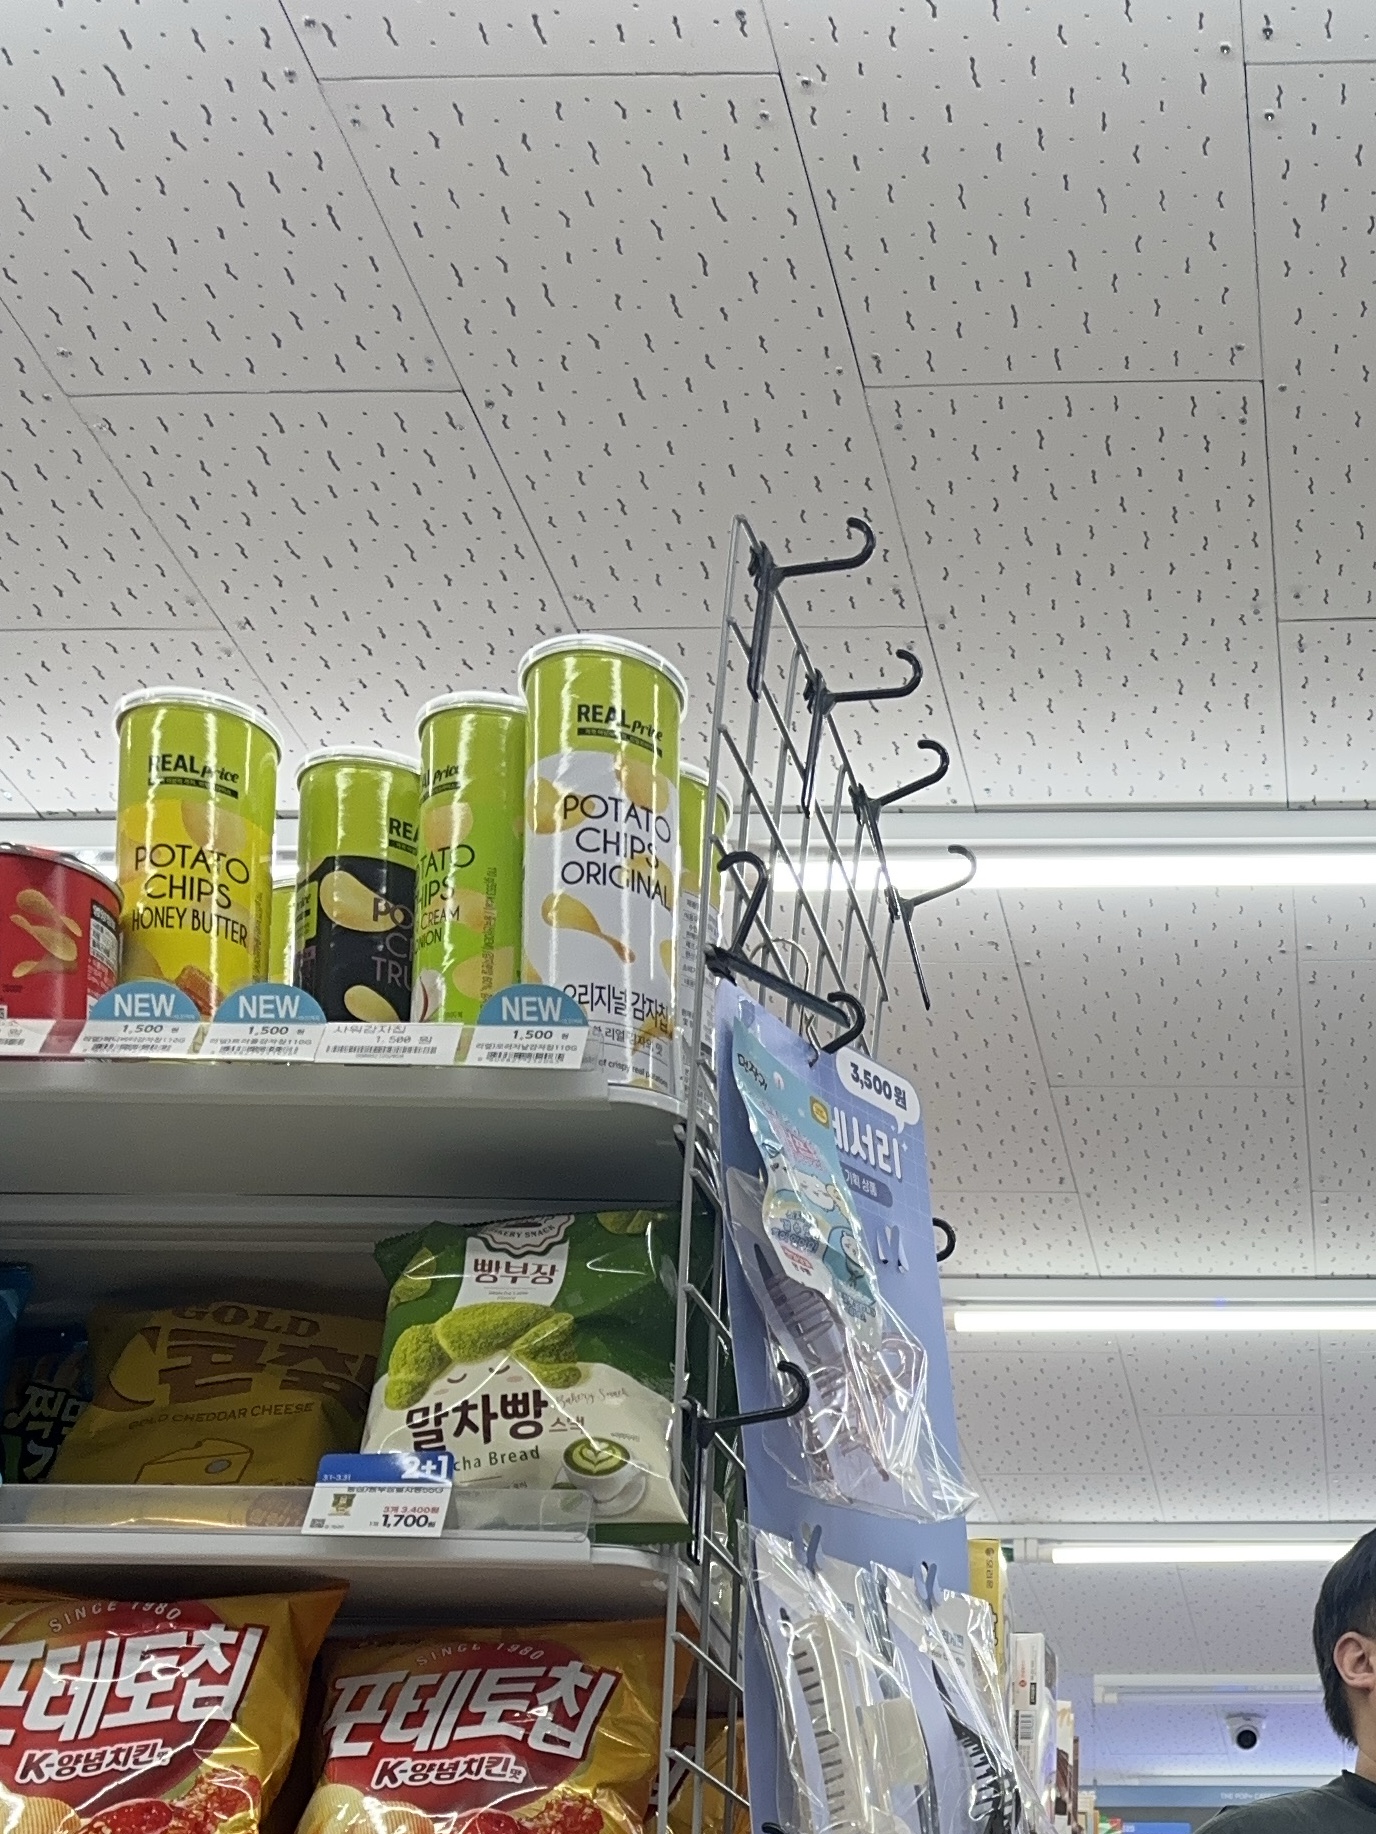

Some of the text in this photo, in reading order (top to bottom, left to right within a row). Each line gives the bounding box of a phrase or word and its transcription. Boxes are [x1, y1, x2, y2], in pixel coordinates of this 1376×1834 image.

[577, 704, 630, 729] REAL
[563, 794, 671, 843] POTATO
[576, 827, 660, 870] CHIPS
[135, 843, 250, 885] POTATO
[144, 874, 232, 910] CHIPS
[562, 861, 671, 911] ORIGINAL
[132, 906, 247, 947] HONEY BUTTER
[421, 906, 460, 931] CREAM
[114, 994, 176, 1018] NEW
[239, 995, 300, 1019] NEW
[502, 996, 563, 1022] NEW
[122, 1024, 164, 1036] 1,500
[248, 1026, 289, 1037] 1,500
[513, 1030, 553, 1041] 1,500
[473, 1258, 559, 1285] 빵부장
[172, 1304, 321, 1338] GOLD
[173, 1407, 247, 1424] CHEDDAR
[251, 1402, 314, 1418] CHEESE
[406, 1389, 549, 1452] 말차빵
[400, 1456, 449, 1483] 2+1
[489, 1446, 540, 1467] Bread
[48, 1601, 117, 1633] SINCE
[323, 1661, 617, 1759] 포테토칩
